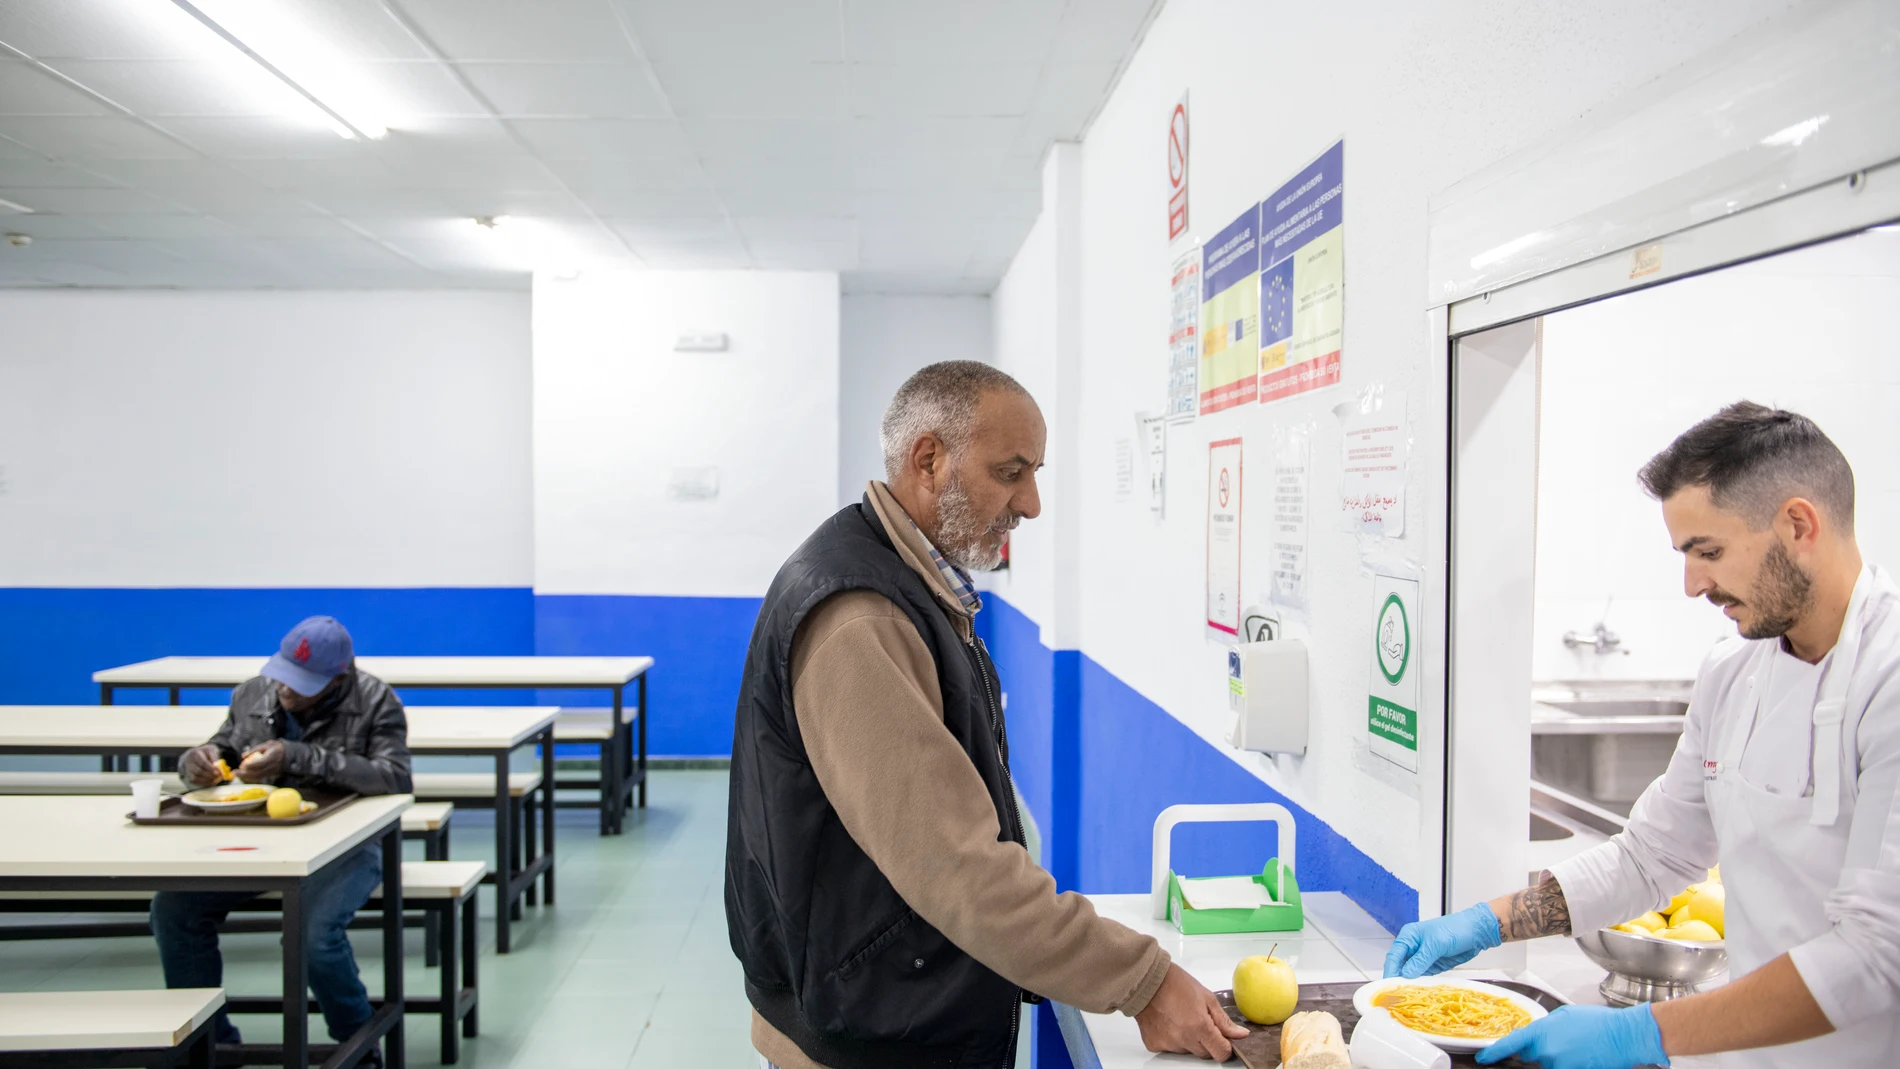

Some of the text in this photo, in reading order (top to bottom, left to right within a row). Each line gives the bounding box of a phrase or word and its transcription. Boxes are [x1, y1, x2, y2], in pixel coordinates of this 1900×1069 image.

[1320, 183, 1342, 205] PERSONAS
[1377, 704, 1406, 725] POR FAVOR
